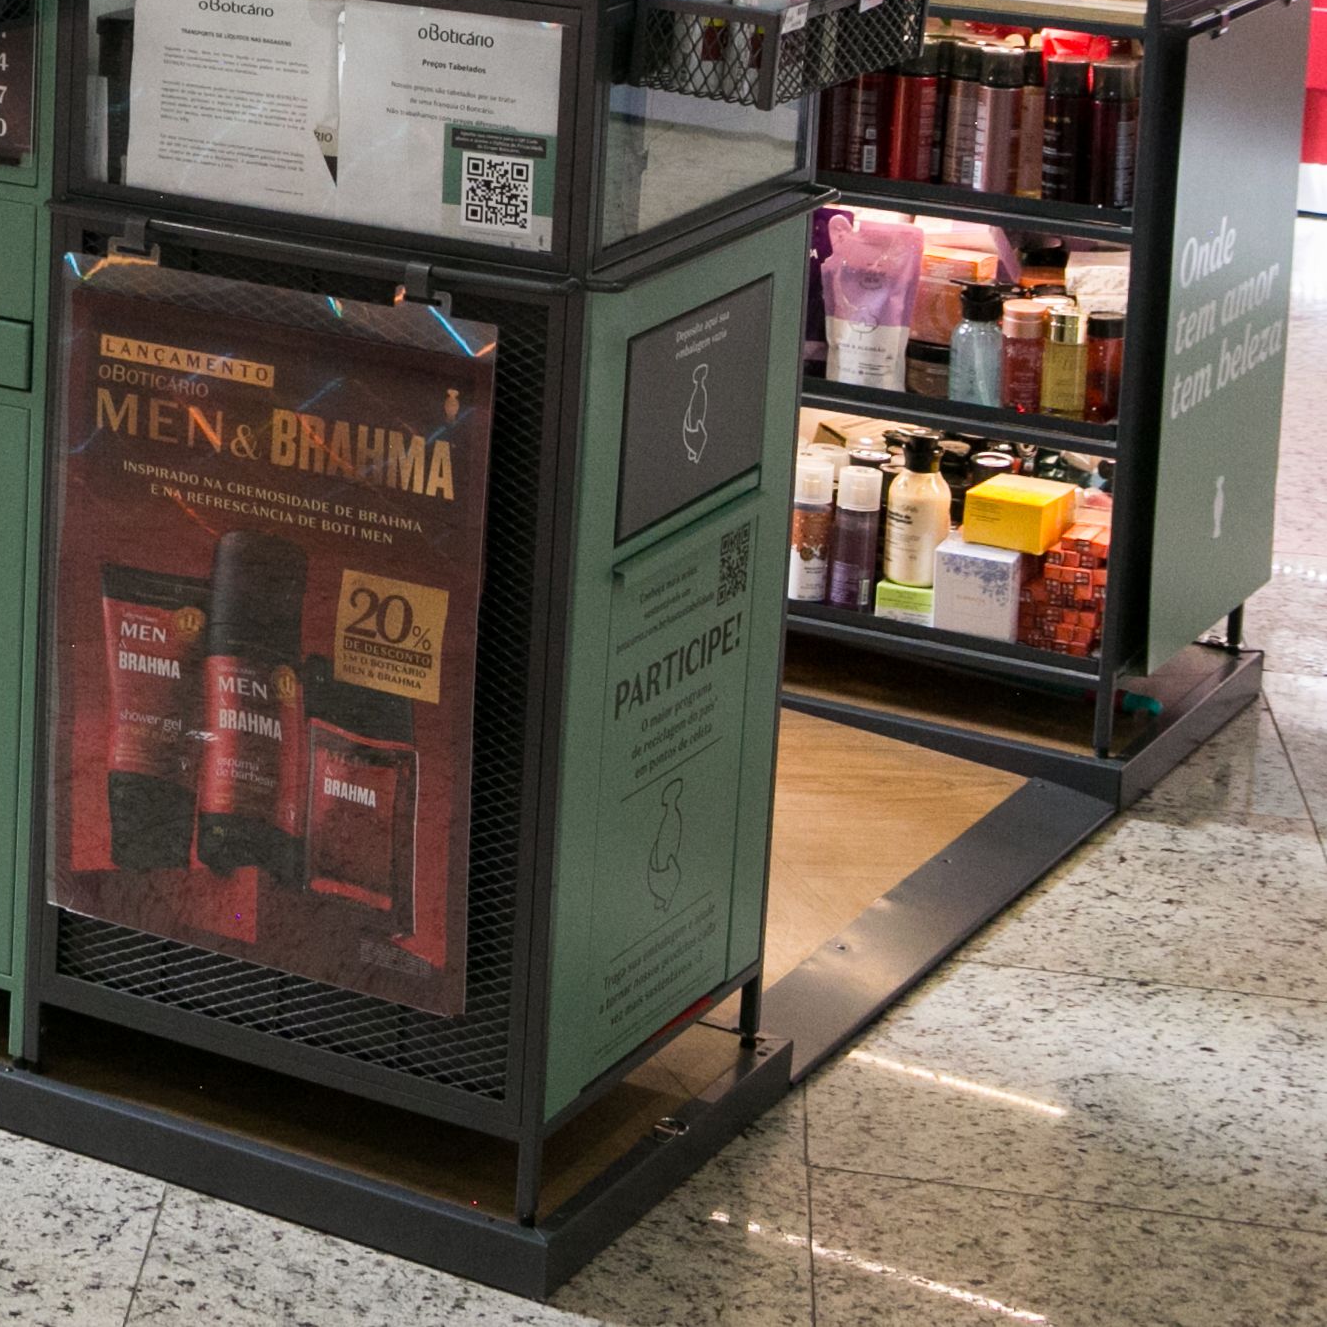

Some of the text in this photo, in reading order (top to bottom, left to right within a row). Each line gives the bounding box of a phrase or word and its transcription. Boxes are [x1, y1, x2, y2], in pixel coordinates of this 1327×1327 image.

[181, 28, 215, 38] TRANSPORTE
[418, 23, 495, 48] oBoticário
[422, 59, 487, 74] Preços Tabelados
[1180, 216, 1237, 289] Onde
[1174, 262, 1280, 356] tem amor
[105, 337, 269, 382] LANÇAMENTO
[1170, 319, 1283, 420] tem beleza
[96, 387, 455, 501] MEN & BRAHMA
[123, 459, 423, 534] INSPIRADO NA CREMOSIDADE DE BRAHMA
[150, 483, 394, 545] E NA REFRESCÂNCIA DE BOTI MEN
[120, 620, 167, 644] MEN
[344, 587, 432, 651] 20%
[118, 650, 181, 680] BRAHMA
[345, 639, 431, 667] DE DESCONTO
[614, 611, 743, 722] PARTICIPE!
[218, 674, 268, 700] MEN
[343, 664, 422, 690] MEN BRAHMA
[119, 709, 160, 728] shower
[163, 716, 182, 733] gel
[218, 708, 283, 742] BRAHMA
[231, 767, 277, 789] barbear
[323, 777, 377, 809] BRAHMA
